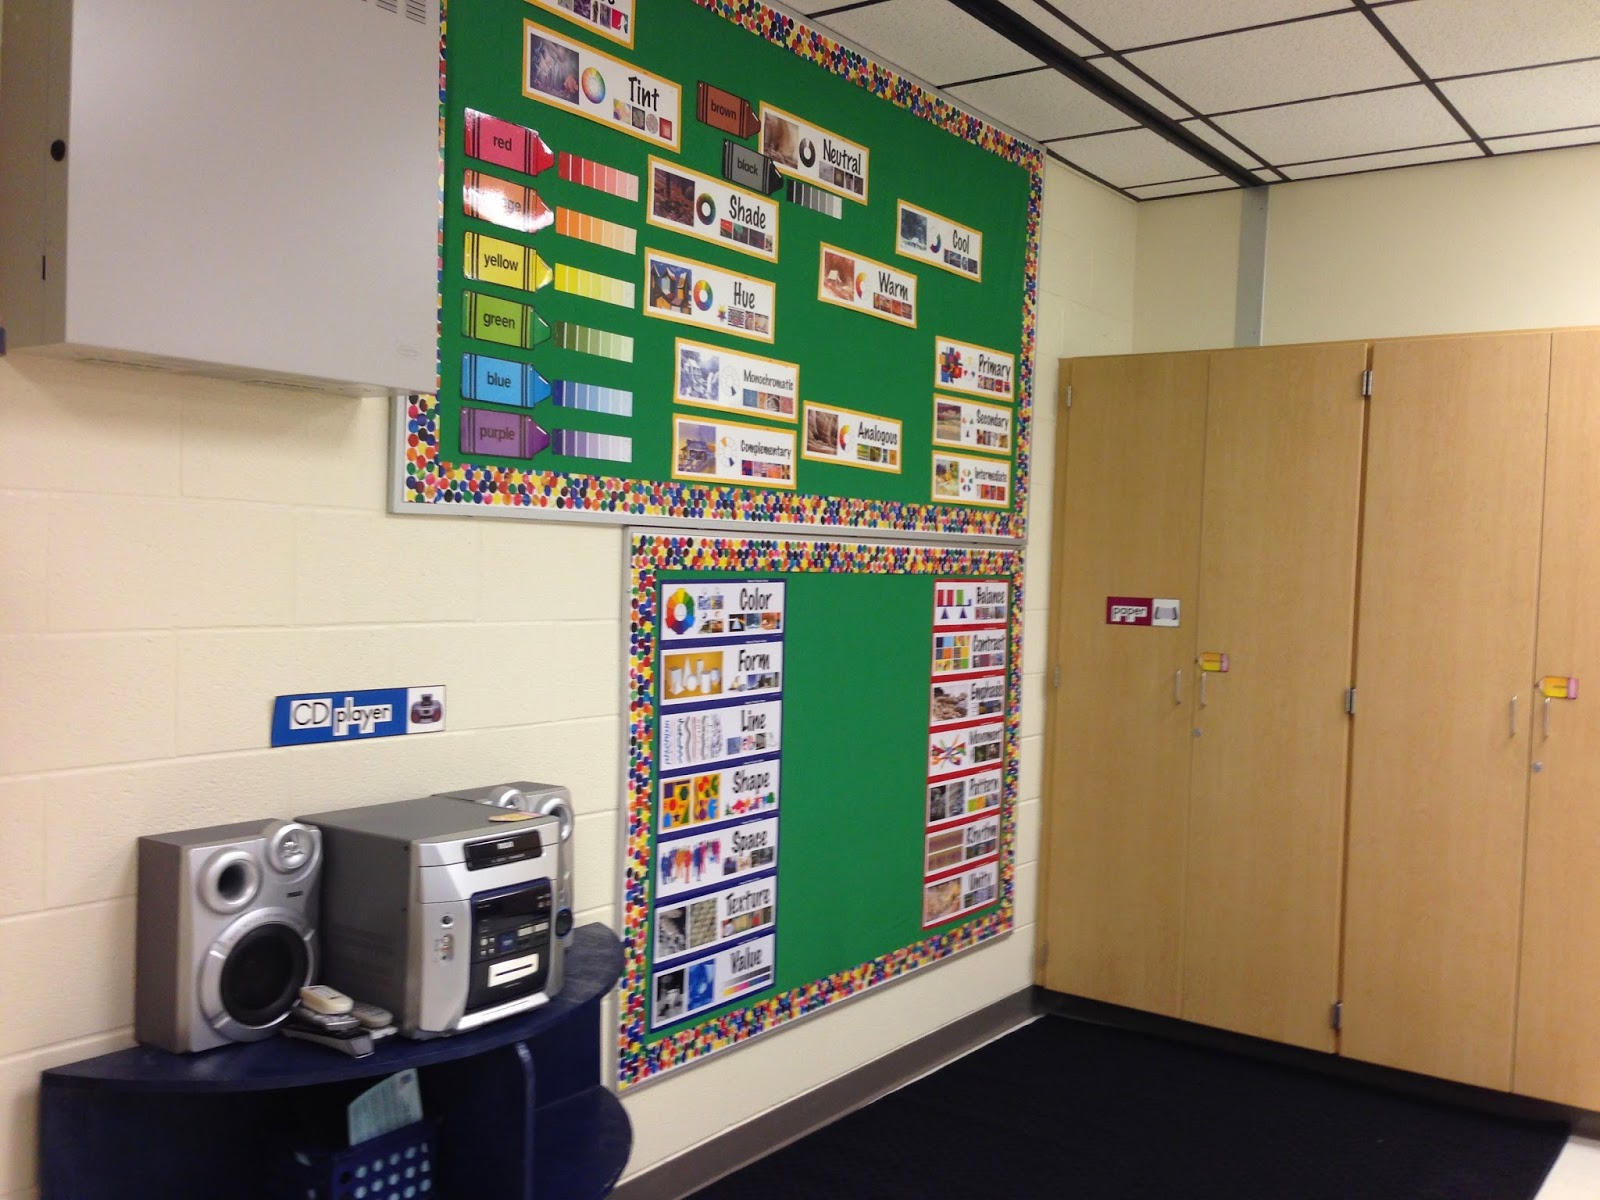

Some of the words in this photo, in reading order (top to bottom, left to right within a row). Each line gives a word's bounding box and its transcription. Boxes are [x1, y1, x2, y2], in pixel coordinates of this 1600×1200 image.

[628, 76, 660, 112] Tint
[711, 101, 737, 120] brown
[493, 135, 512, 151] red
[737, 157, 759, 176] black
[823, 138, 862, 175] Neutral
[729, 194, 766, 230] Shade
[952, 229, 970, 254] Cool
[484, 253, 518, 271] yellow
[733, 281, 755, 309] Hue
[879, 271, 908, 301] Warm
[483, 312, 515, 329] green
[487, 371, 511, 388] blue
[978, 354, 1011, 381] Primary
[743, 369, 794, 391] Monochromatic
[976, 409, 1009, 431] Secondary
[480, 425, 516, 442] purple
[858, 421, 898, 446] Analogous
[741, 439, 792, 460] Complementary
[740, 587, 772, 611] Color
[1113, 606, 1146, 621] paper
[738, 649, 770, 672] Form
[292, 701, 329, 725] CD
[335, 698, 391, 734] player
[741, 709, 766, 732] Line
[732, 769, 770, 795] Shape
[731, 830, 768, 857] Space
[726, 886, 770, 917] Texture
[730, 946, 763, 976] Value
